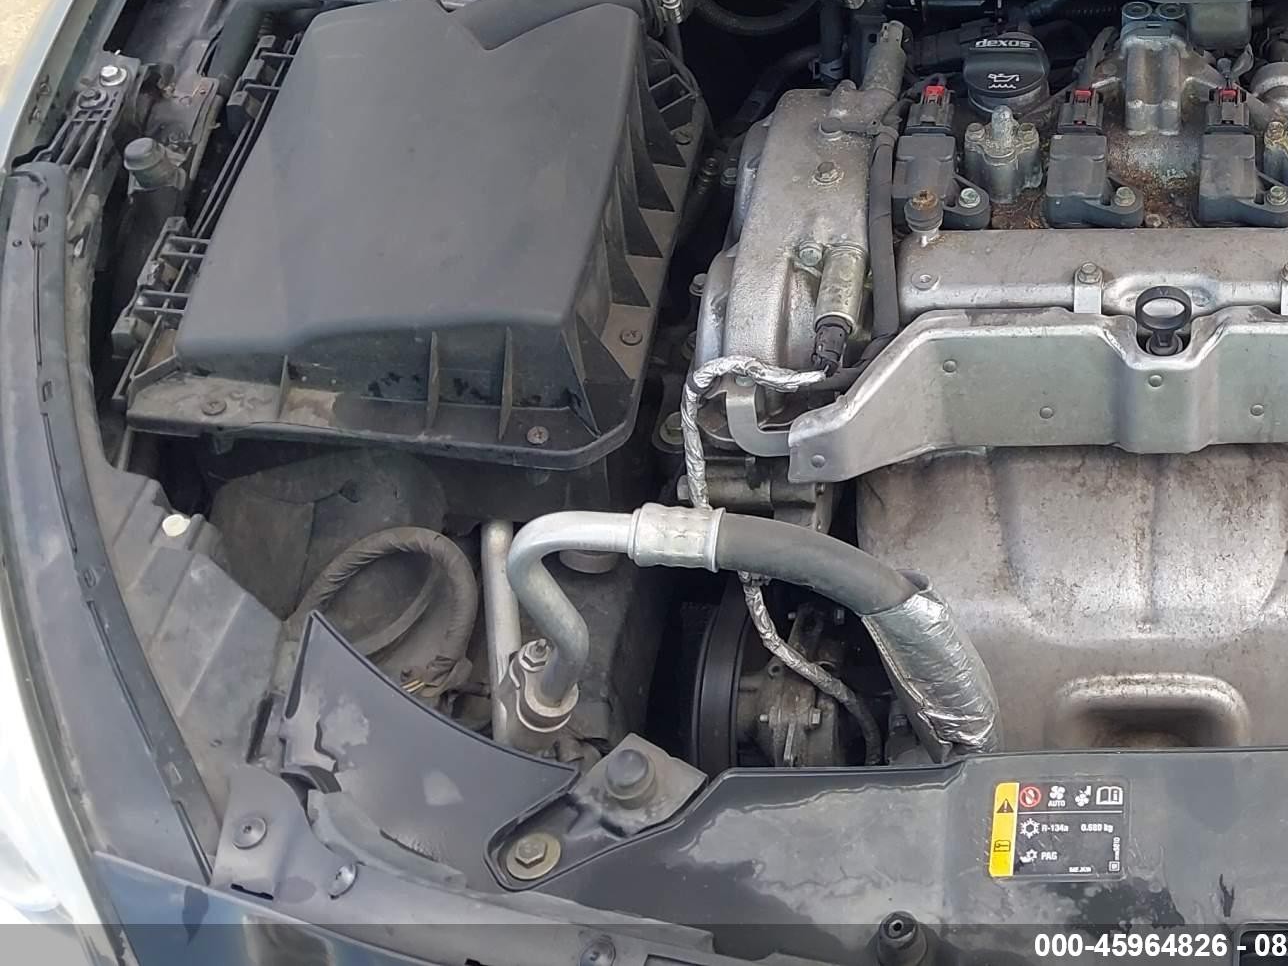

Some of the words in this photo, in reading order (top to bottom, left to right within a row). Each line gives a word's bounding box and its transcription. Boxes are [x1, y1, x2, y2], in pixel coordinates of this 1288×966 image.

[975, 39, 1033, 48] dexos
[1041, 824, 1069, 832] R-134a
[1041, 851, 1057, 860] PAG
